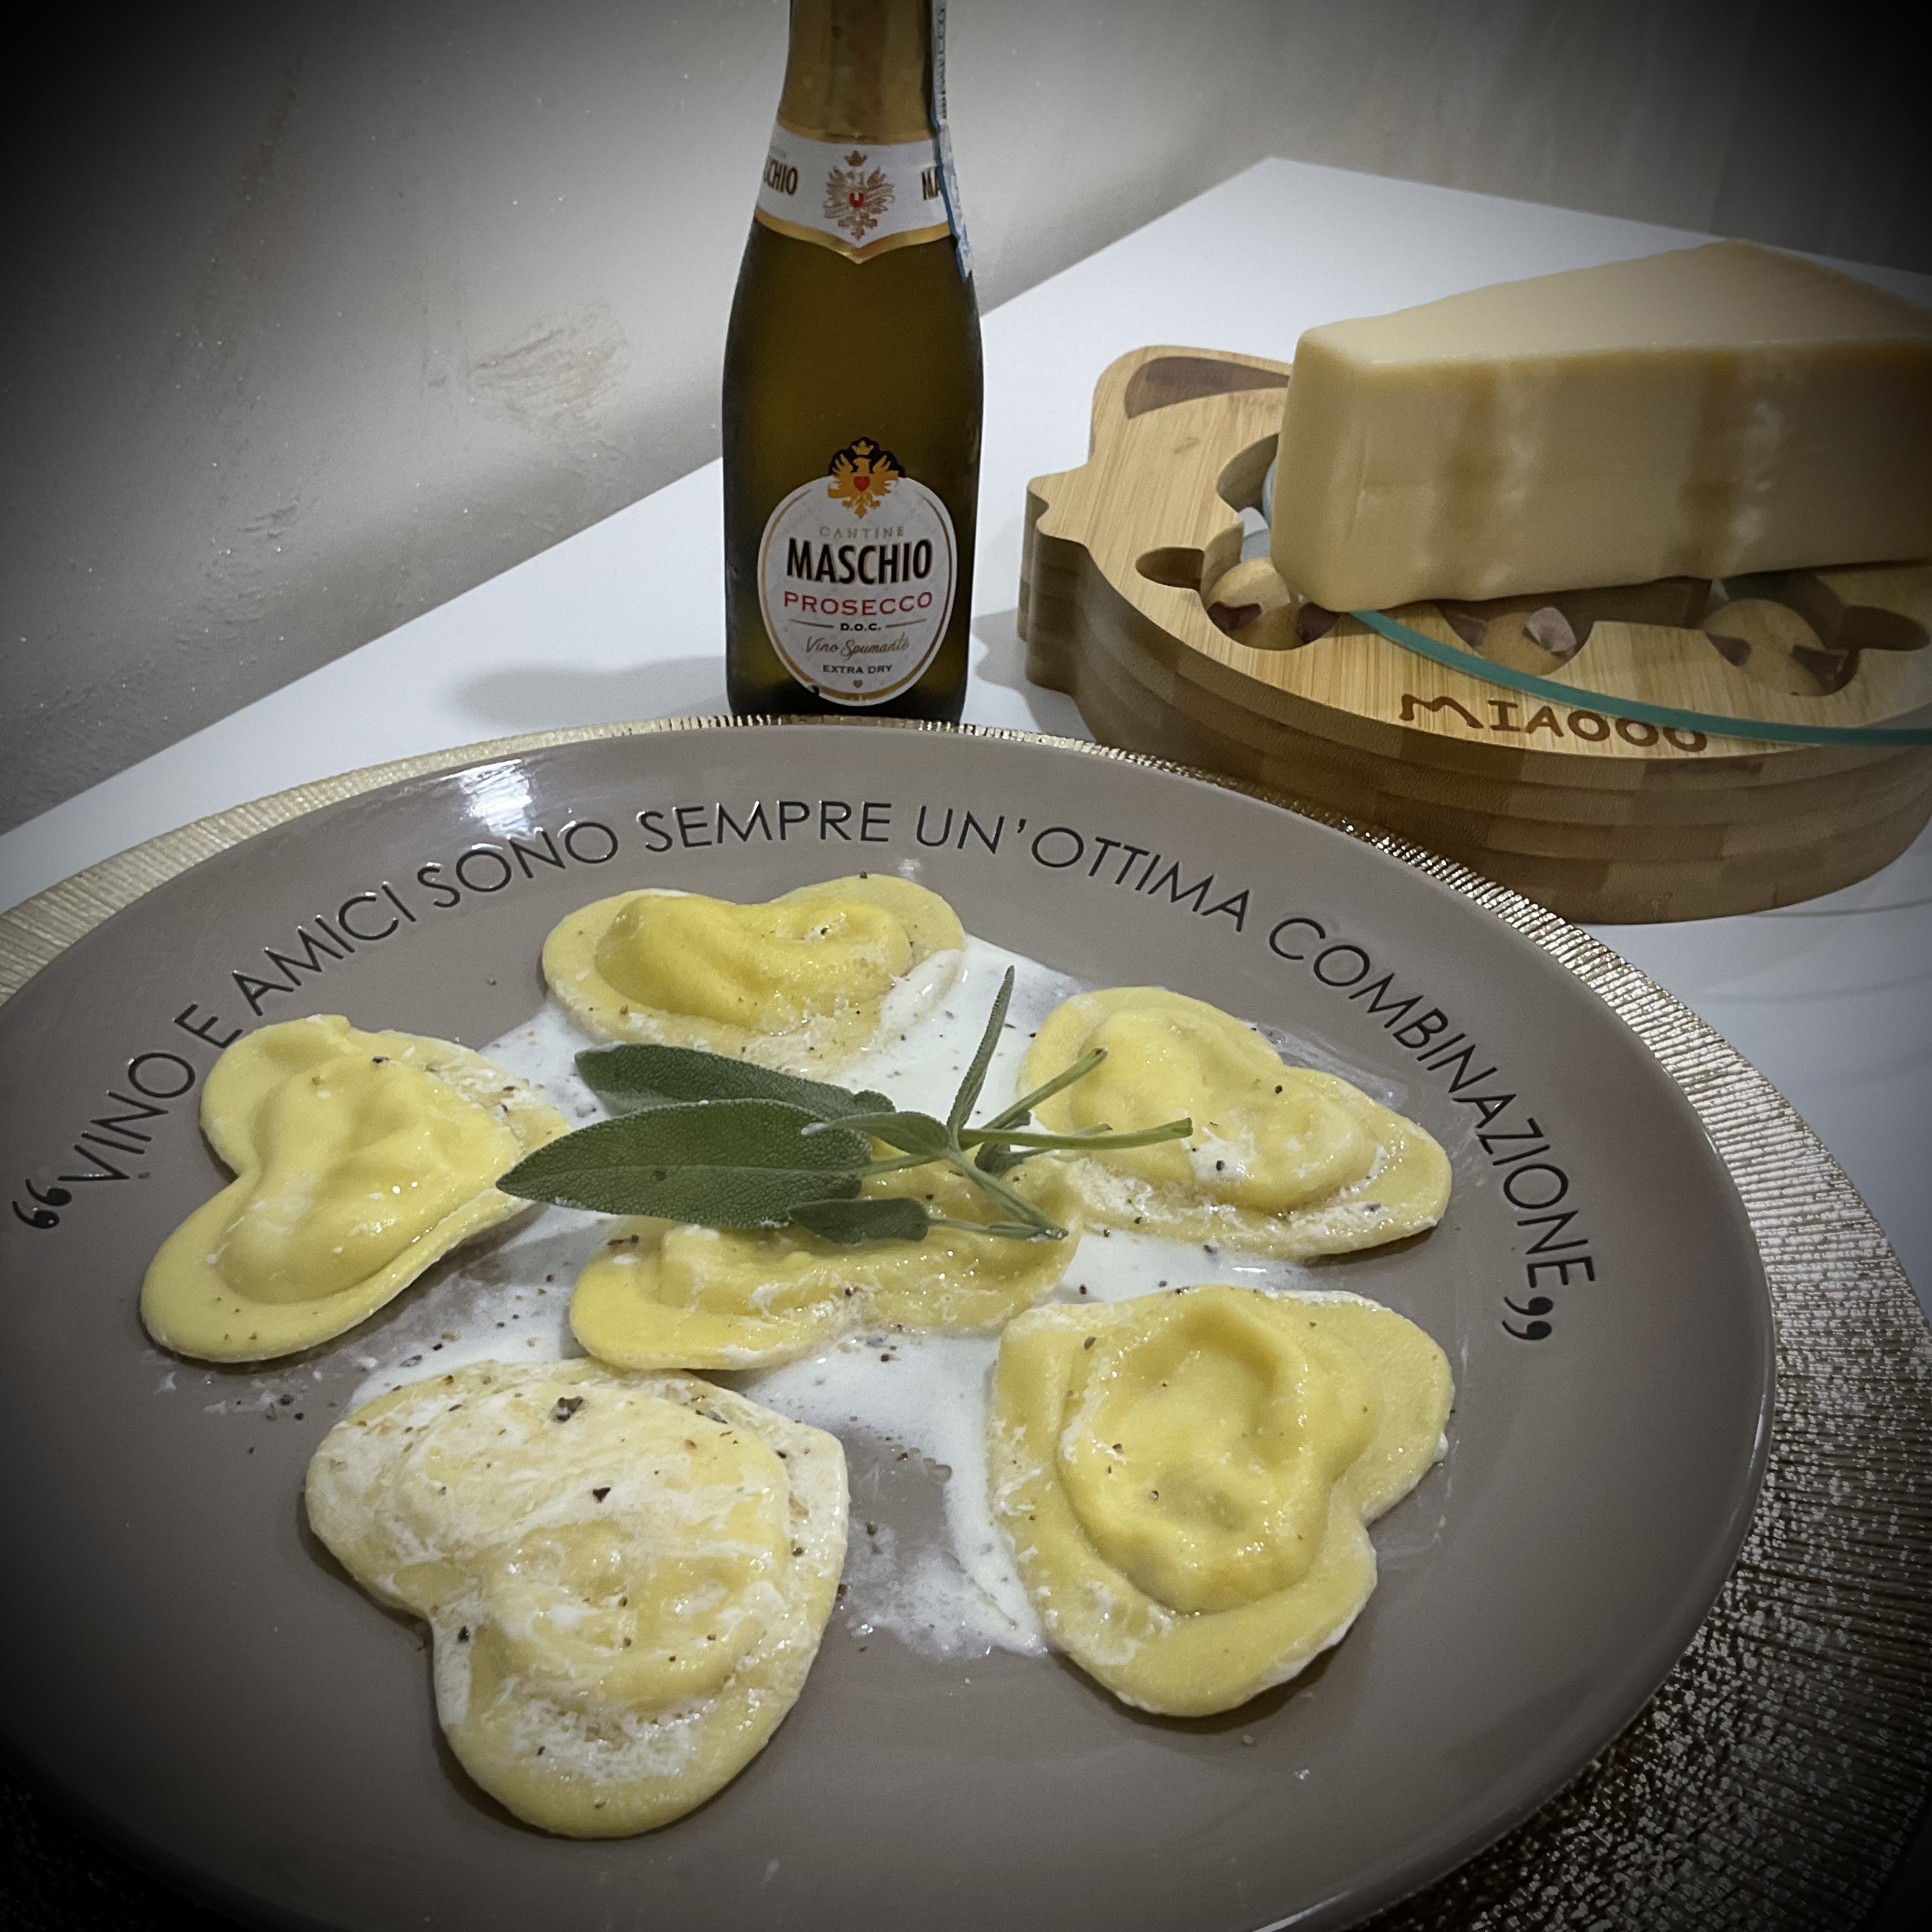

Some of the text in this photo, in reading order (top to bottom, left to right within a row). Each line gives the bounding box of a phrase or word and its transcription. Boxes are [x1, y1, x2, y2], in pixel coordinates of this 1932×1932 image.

[818, 526, 905, 539] CANTINE
[786, 537, 933, 585] MASCHIO
[783, 591, 933, 616] PROSECCO
[840, 623, 882, 631] D.O.C.
[806, 632, 910, 661] Vino Spumante
[823, 664, 893, 673] EXTRA DRY
[1399, 693, 1708, 753] MIAOOO
[174, 1003, 243, 1048] E
[231, 882, 417, 1016] AMICI
[417, 821, 618, 908] SONO
[637, 800, 893, 853] SEMPRE
